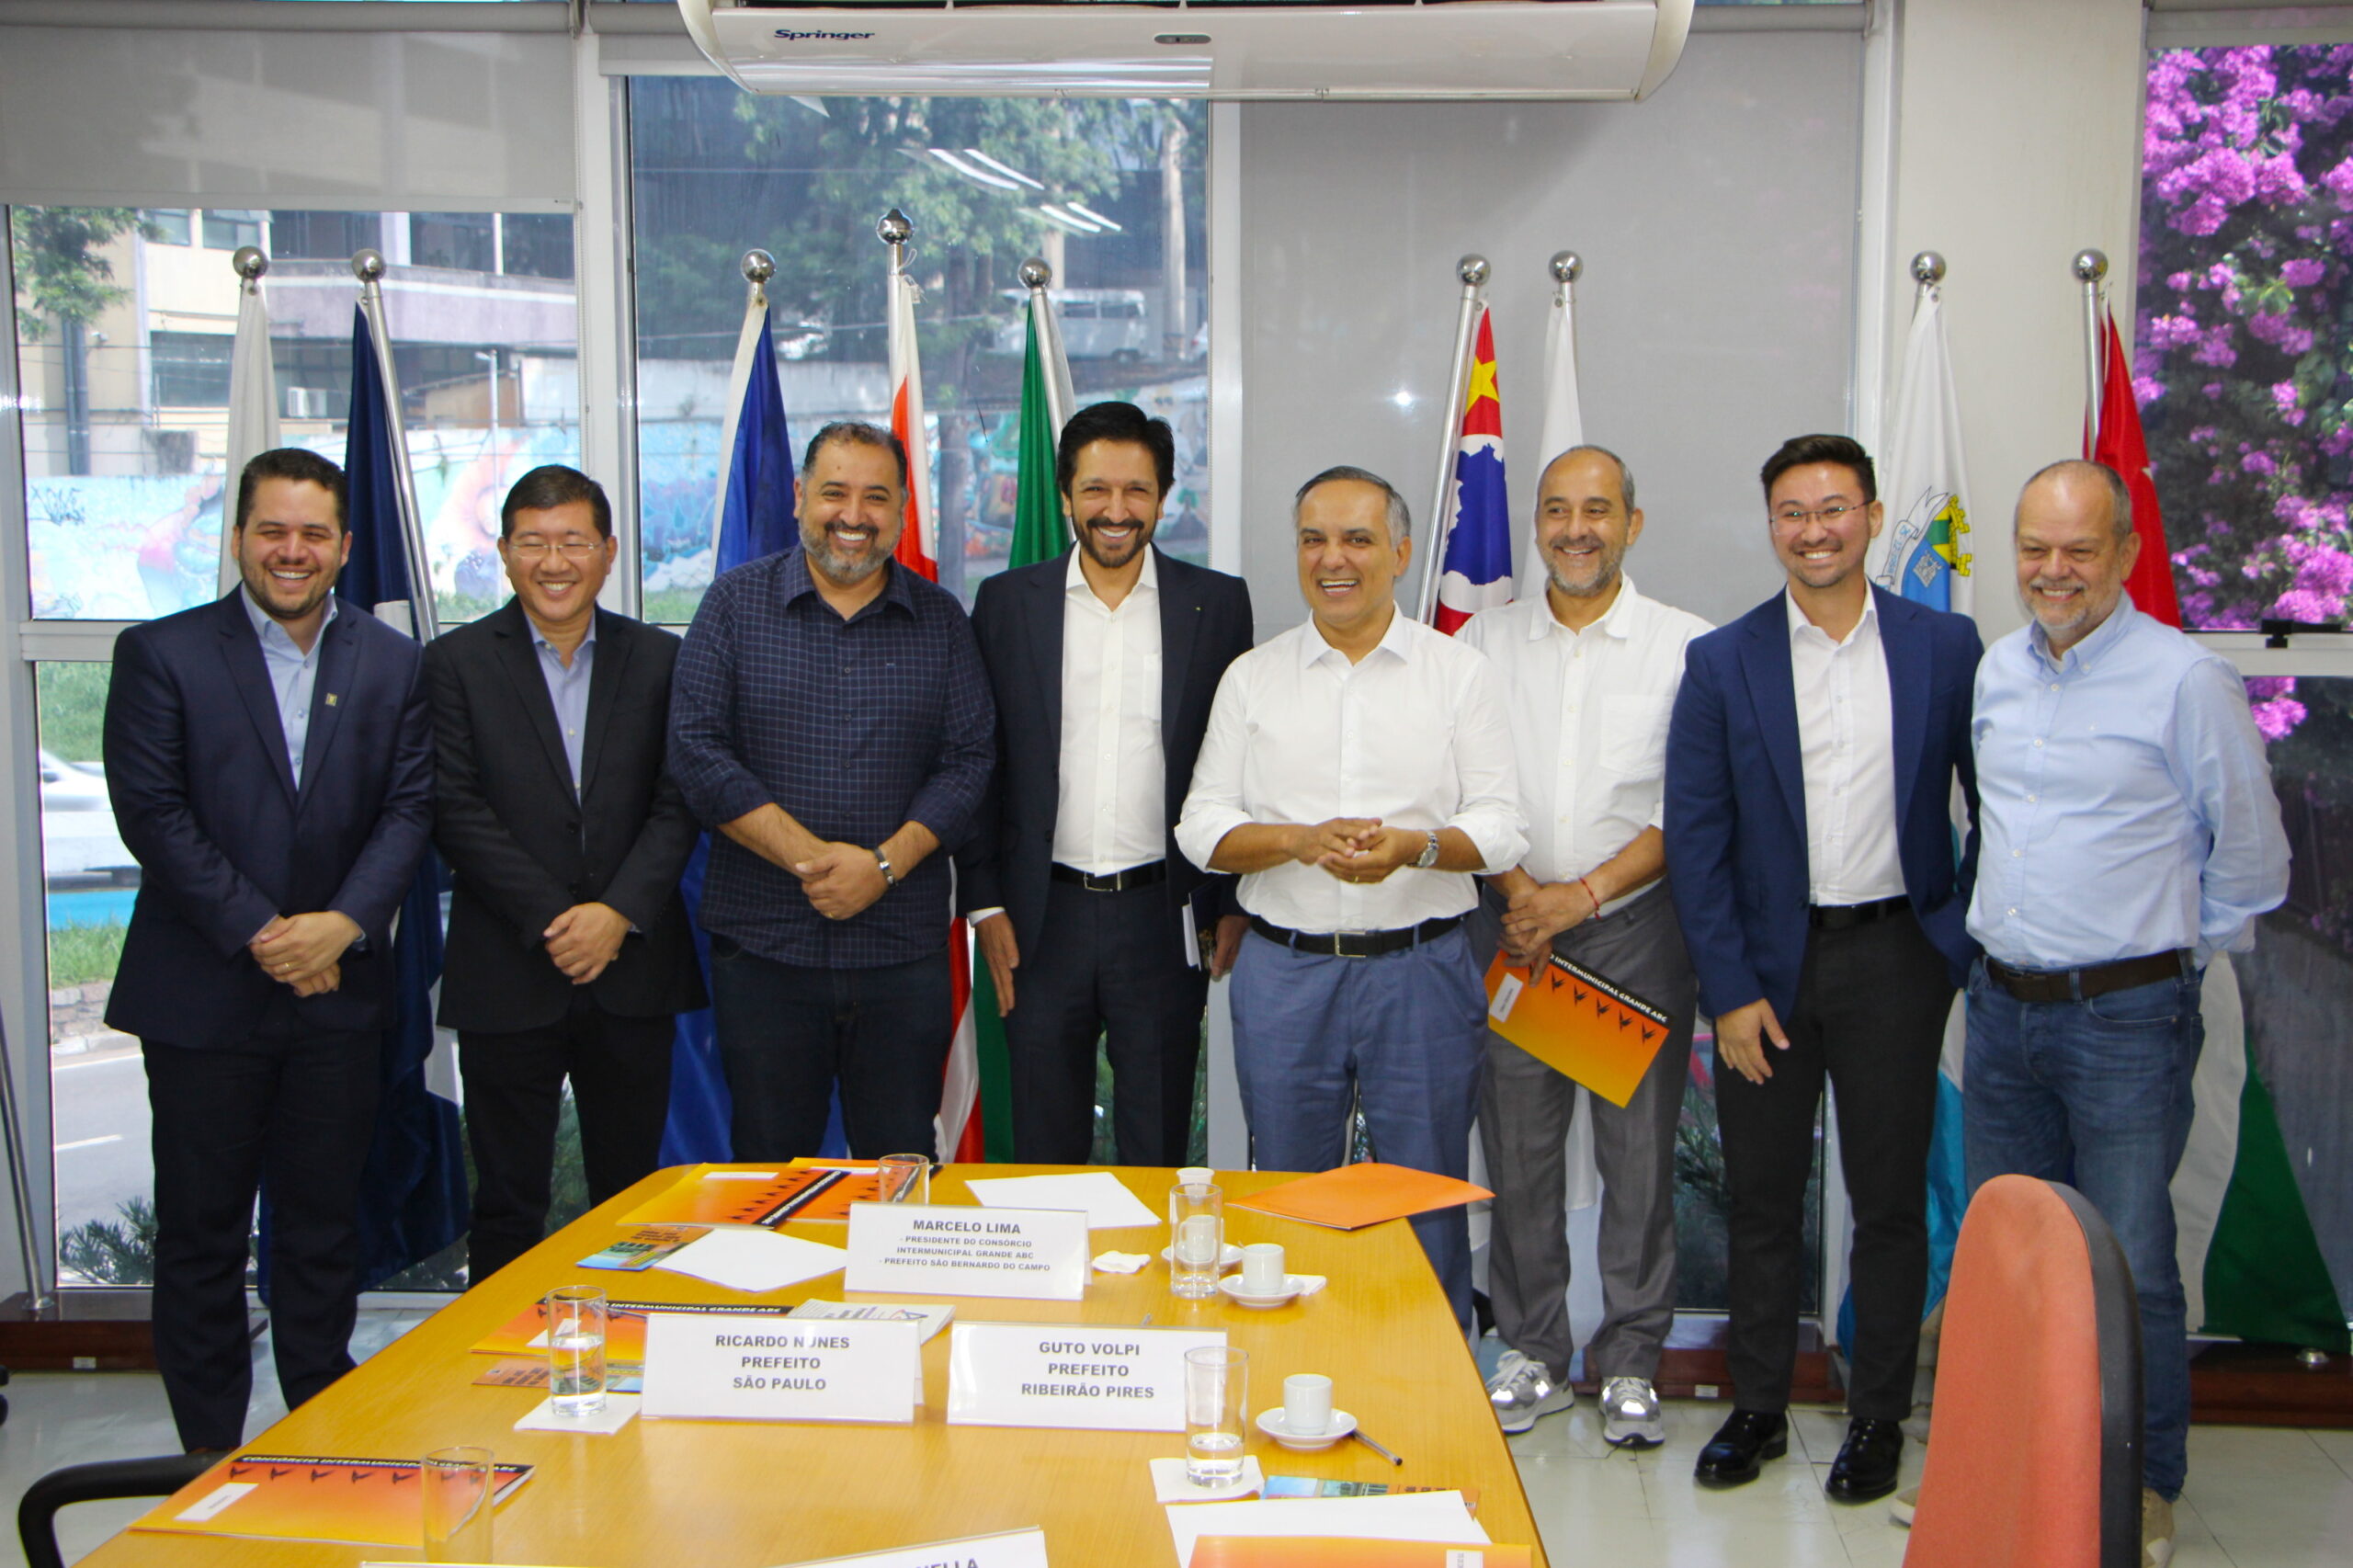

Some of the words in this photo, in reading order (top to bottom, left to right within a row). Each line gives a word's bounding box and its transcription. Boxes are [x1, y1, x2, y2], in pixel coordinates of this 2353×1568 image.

[774, 28, 876, 41] Springer
[1554, 956, 1619, 995] INTERMUNICIPAL
[1619, 993, 1652, 1014] GRANDE
[1651, 1010, 1668, 1023] ABC
[913, 1220, 982, 1233] MARCELO
[986, 1222, 1021, 1234] LIMA
[905, 1235, 961, 1245] PRESIDENTE
[979, 1237, 1032, 1247] CONSÓRCIO
[896, 1246, 972, 1256] INTERMUNICIPAL
[975, 1250, 1013, 1258] GRANDE
[884, 1257, 927, 1267] PREFEITO
[930, 1257, 949, 1267] SÃO
[951, 1260, 1000, 1270] BERNARDO
[1018, 1263, 1051, 1271] CAMPO
[715, 1335, 788, 1348] RICARDO
[1039, 1342, 1086, 1355] GUTO
[1091, 1344, 1140, 1356] VOLPI
[741, 1356, 821, 1369] PREFEITO
[1048, 1363, 1130, 1377] PREFEITO
[733, 1375, 767, 1389] SÃO
[771, 1378, 826, 1390] PAULO
[1021, 1382, 1100, 1397] RIBEIRÃO
[1106, 1386, 1154, 1398] PIRES
